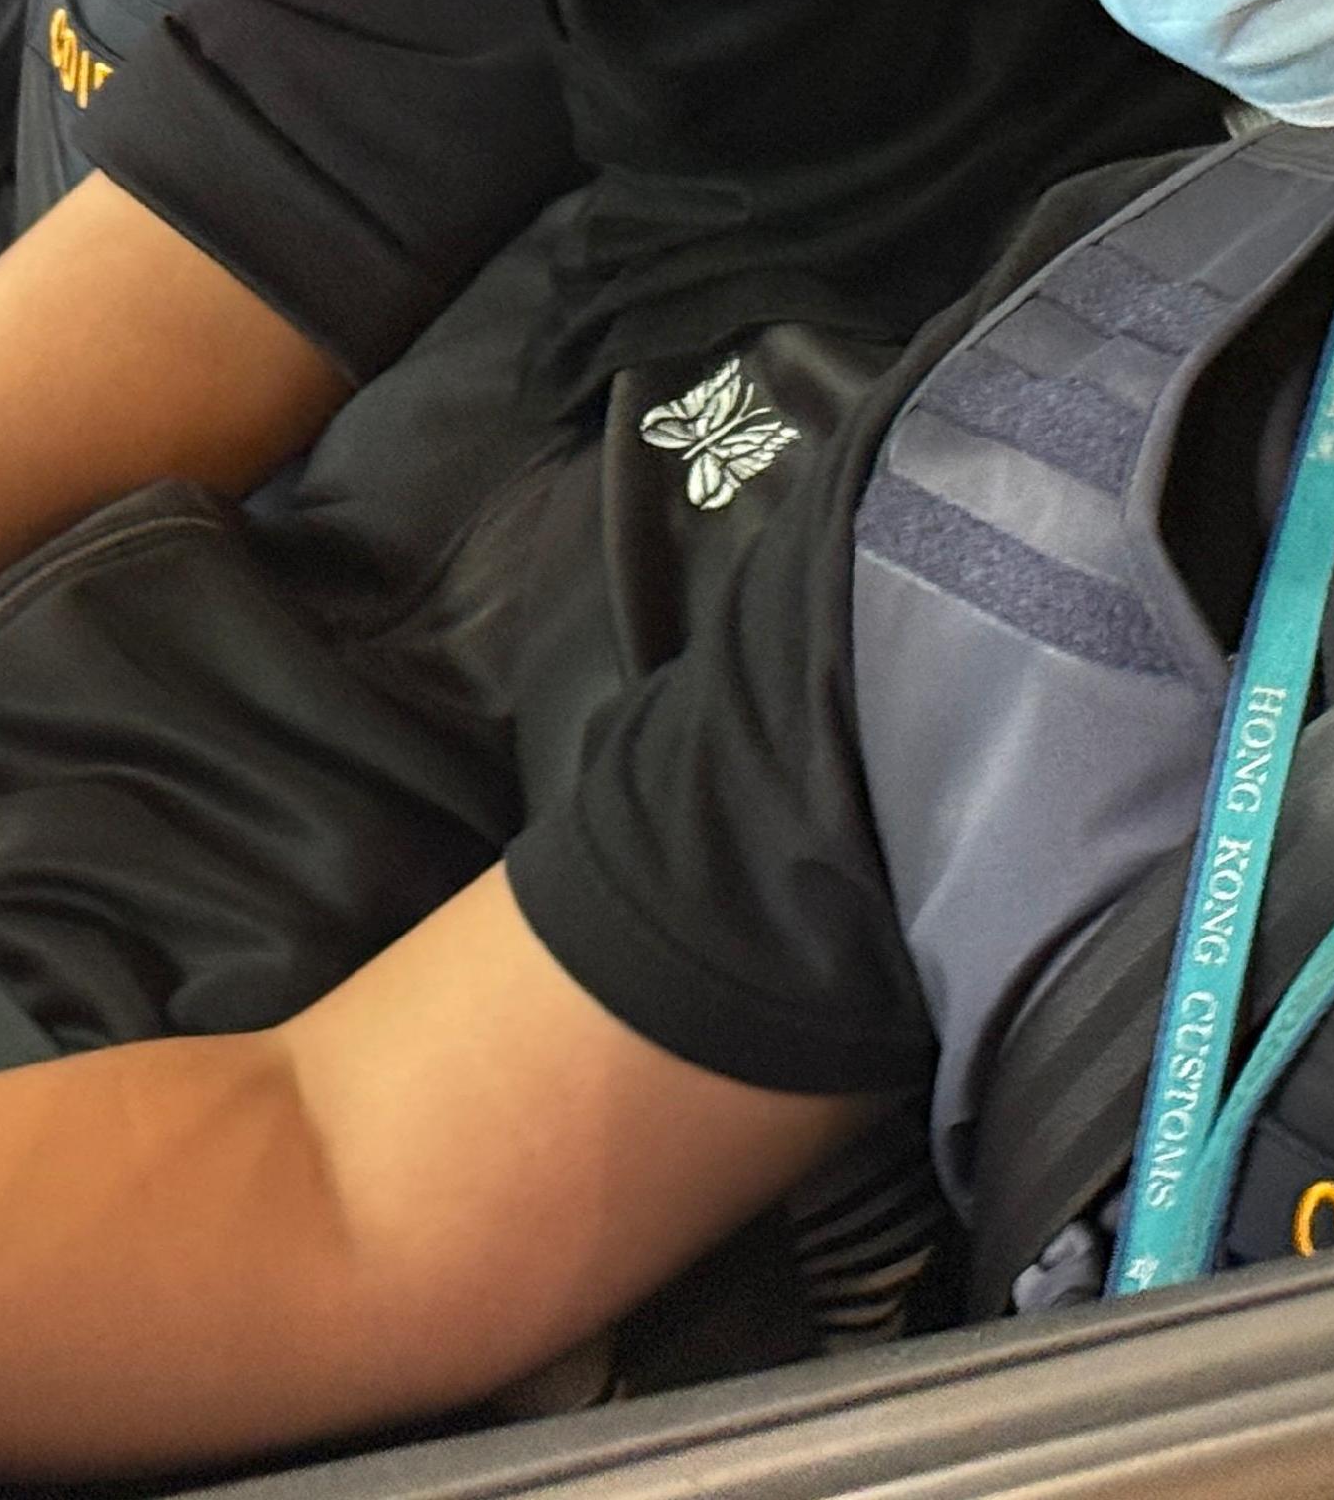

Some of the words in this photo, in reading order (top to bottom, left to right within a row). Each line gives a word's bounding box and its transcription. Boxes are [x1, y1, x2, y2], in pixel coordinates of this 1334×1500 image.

[1226, 683, 1288, 814] HONG
[1193, 835, 1253, 966] KONG
[1146, 990, 1216, 1210] CUSTOMS
